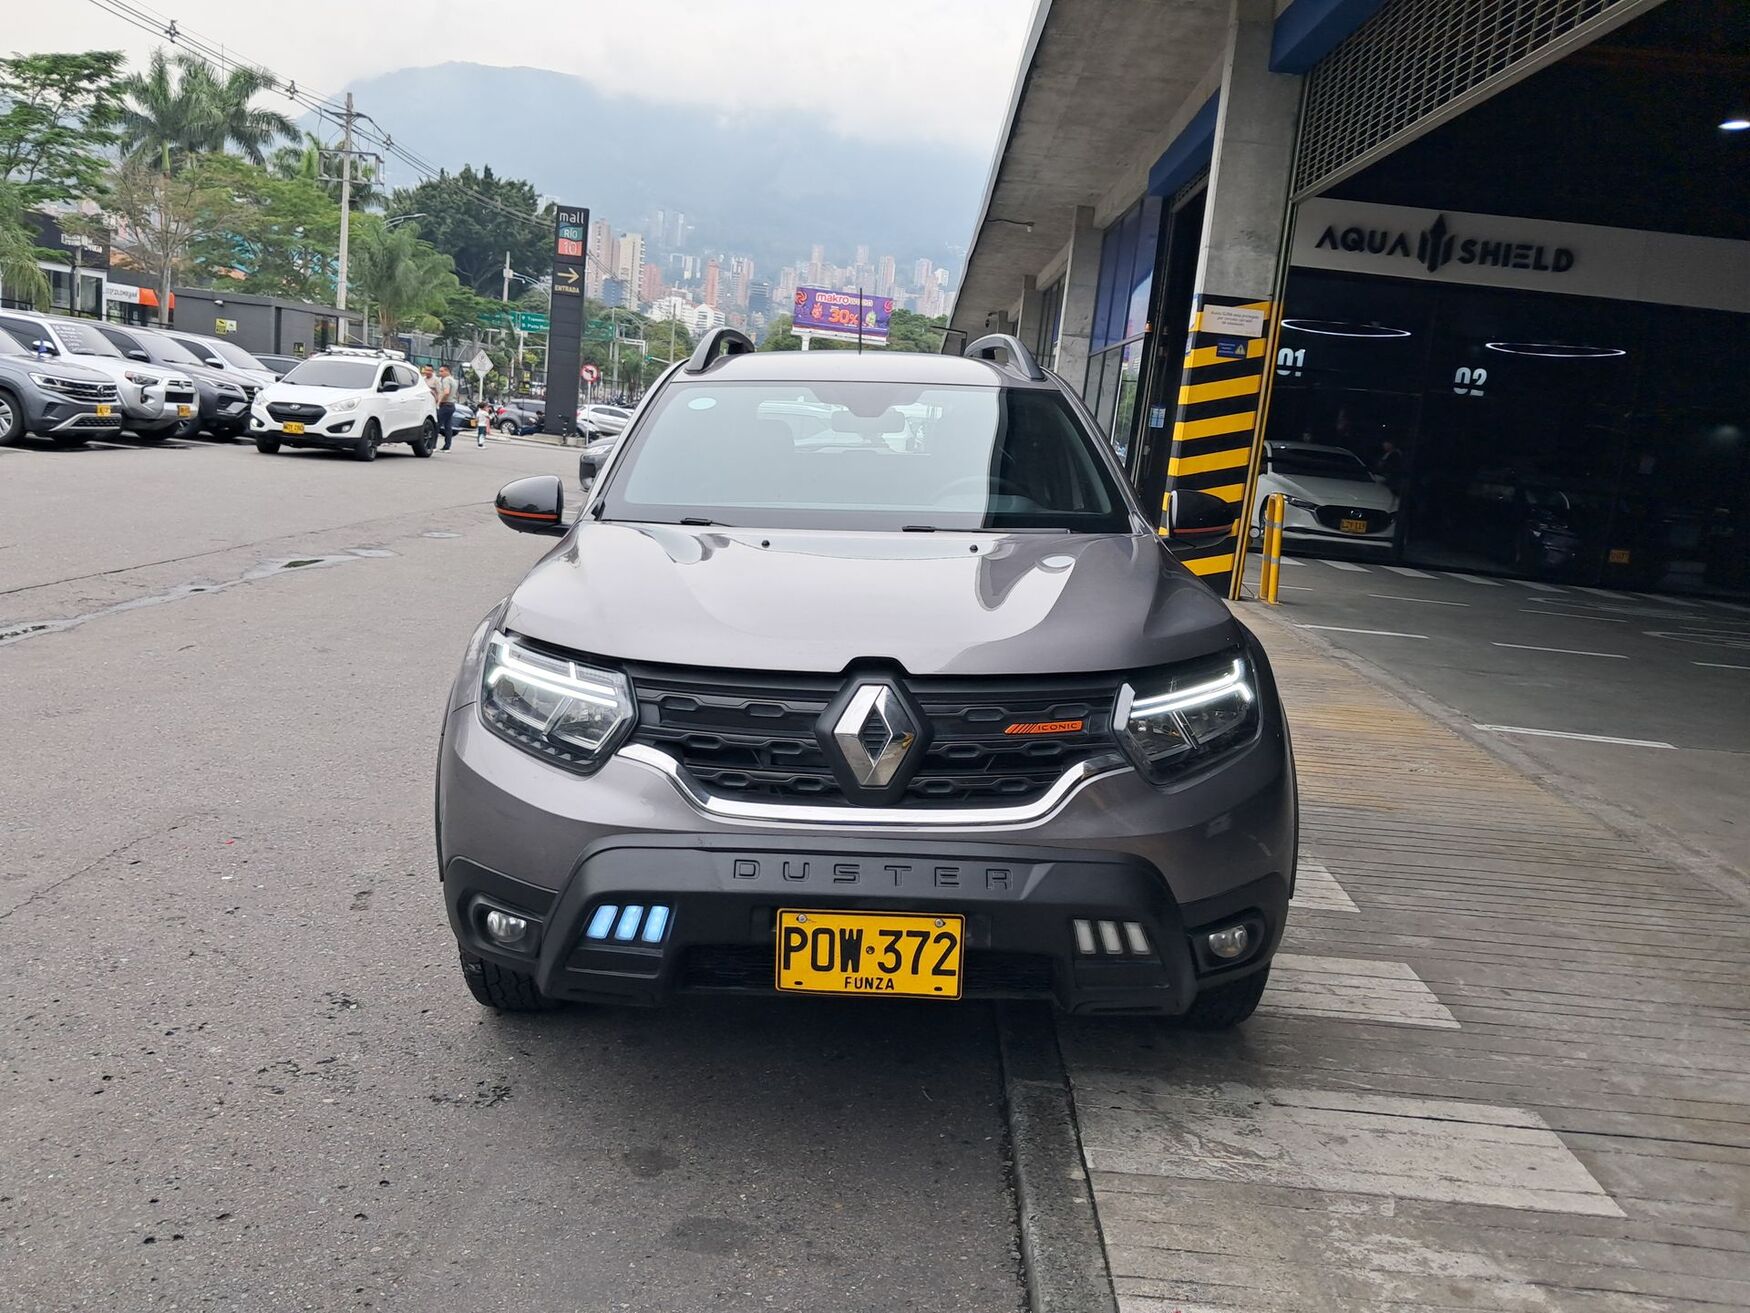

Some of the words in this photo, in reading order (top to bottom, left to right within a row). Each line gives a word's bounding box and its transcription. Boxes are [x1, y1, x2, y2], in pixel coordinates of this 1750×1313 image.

[559, 211, 584, 224] mall
[1313, 224, 1412, 254] AQUA
[1456, 237, 1576, 273] SHIELD
[554, 284, 580, 294] ENTRADA
[1276, 347, 1306, 377] 01
[1453, 366, 1488, 397] 02
[1038, 722, 1078, 732] ICONIC
[733, 858, 1014, 891] DUSTER
[844, 976, 895, 991] FUNZA
